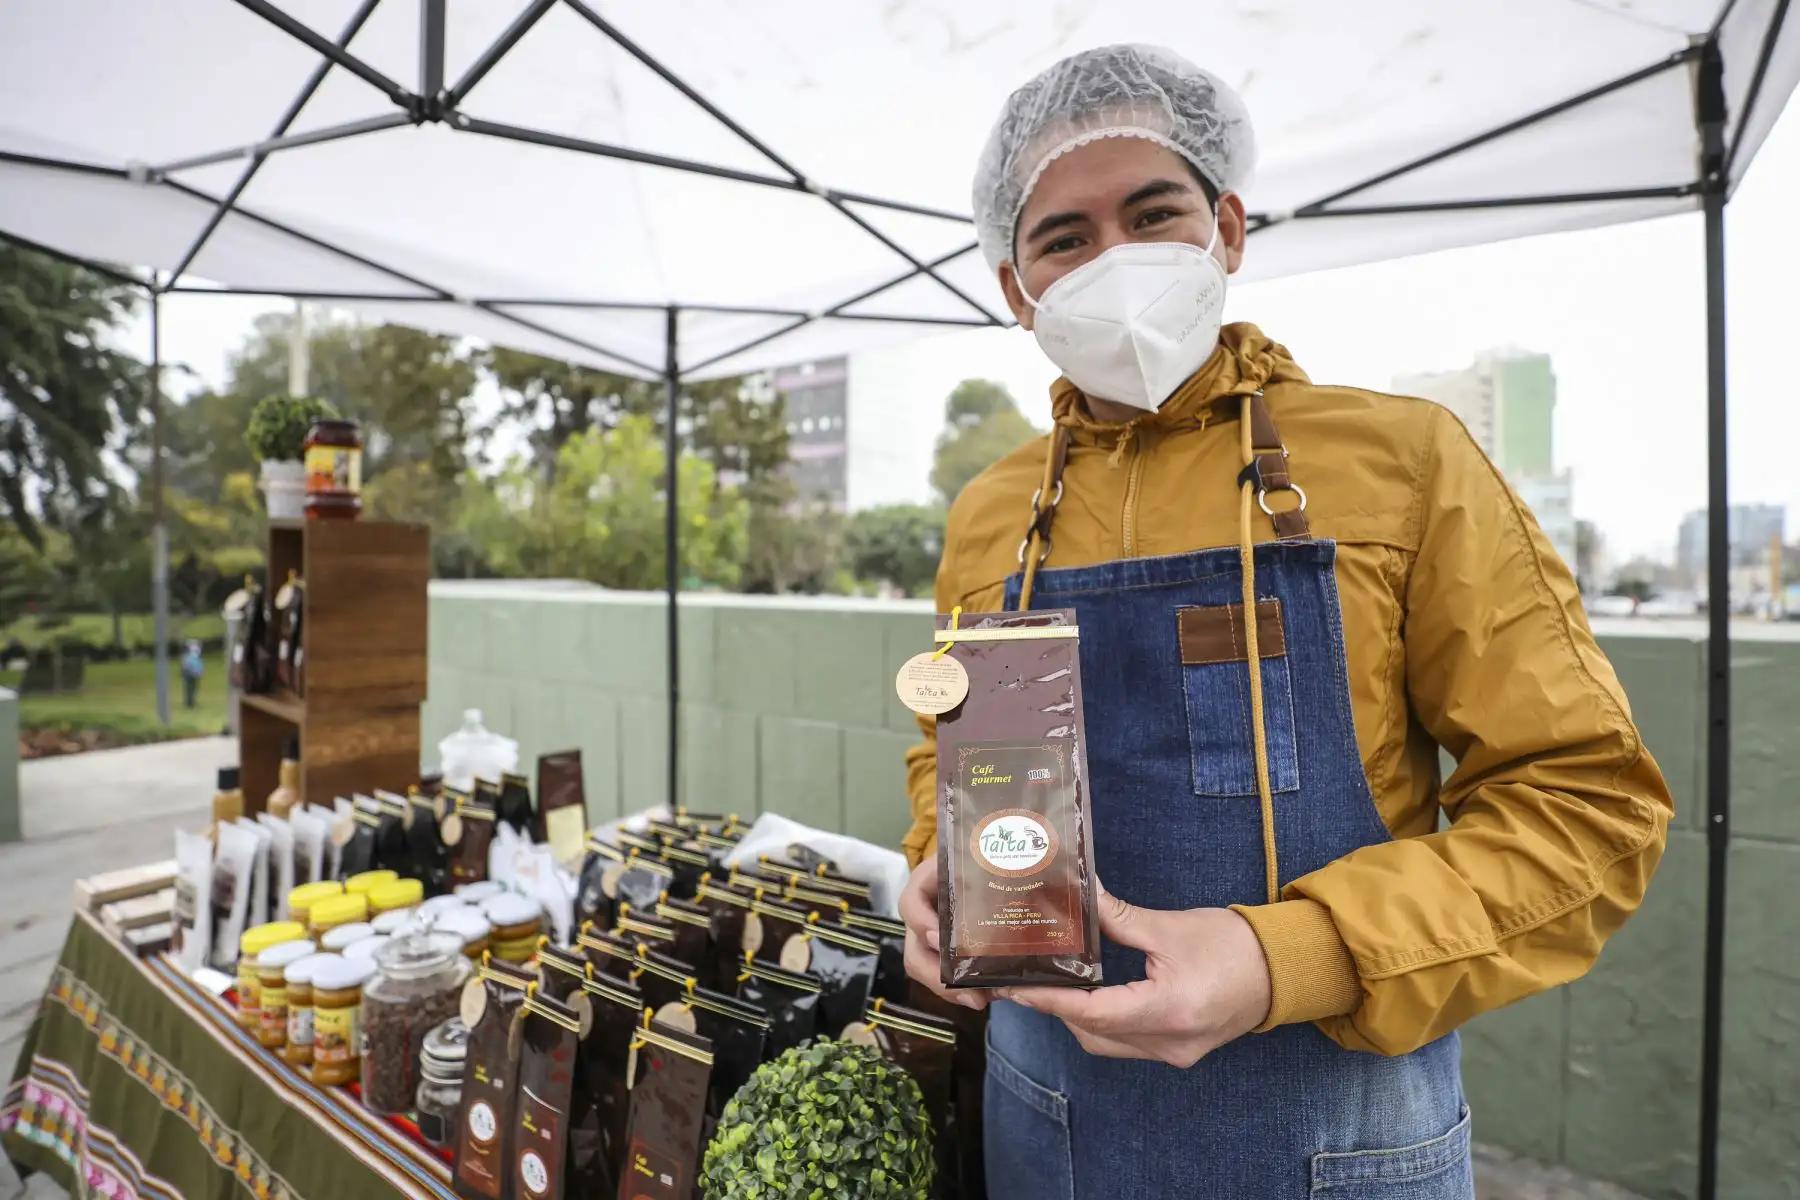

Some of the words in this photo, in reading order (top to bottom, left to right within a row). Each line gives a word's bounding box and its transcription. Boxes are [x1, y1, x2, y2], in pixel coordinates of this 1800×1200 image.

[971, 765, 994, 775] Café
[1027, 768, 1051, 781] 100%
[970, 774, 1012, 787] gourmet
[981, 833, 1026, 852] Taita
[988, 881, 1005, 891] Blend
[1013, 881, 1044, 892] variedades
